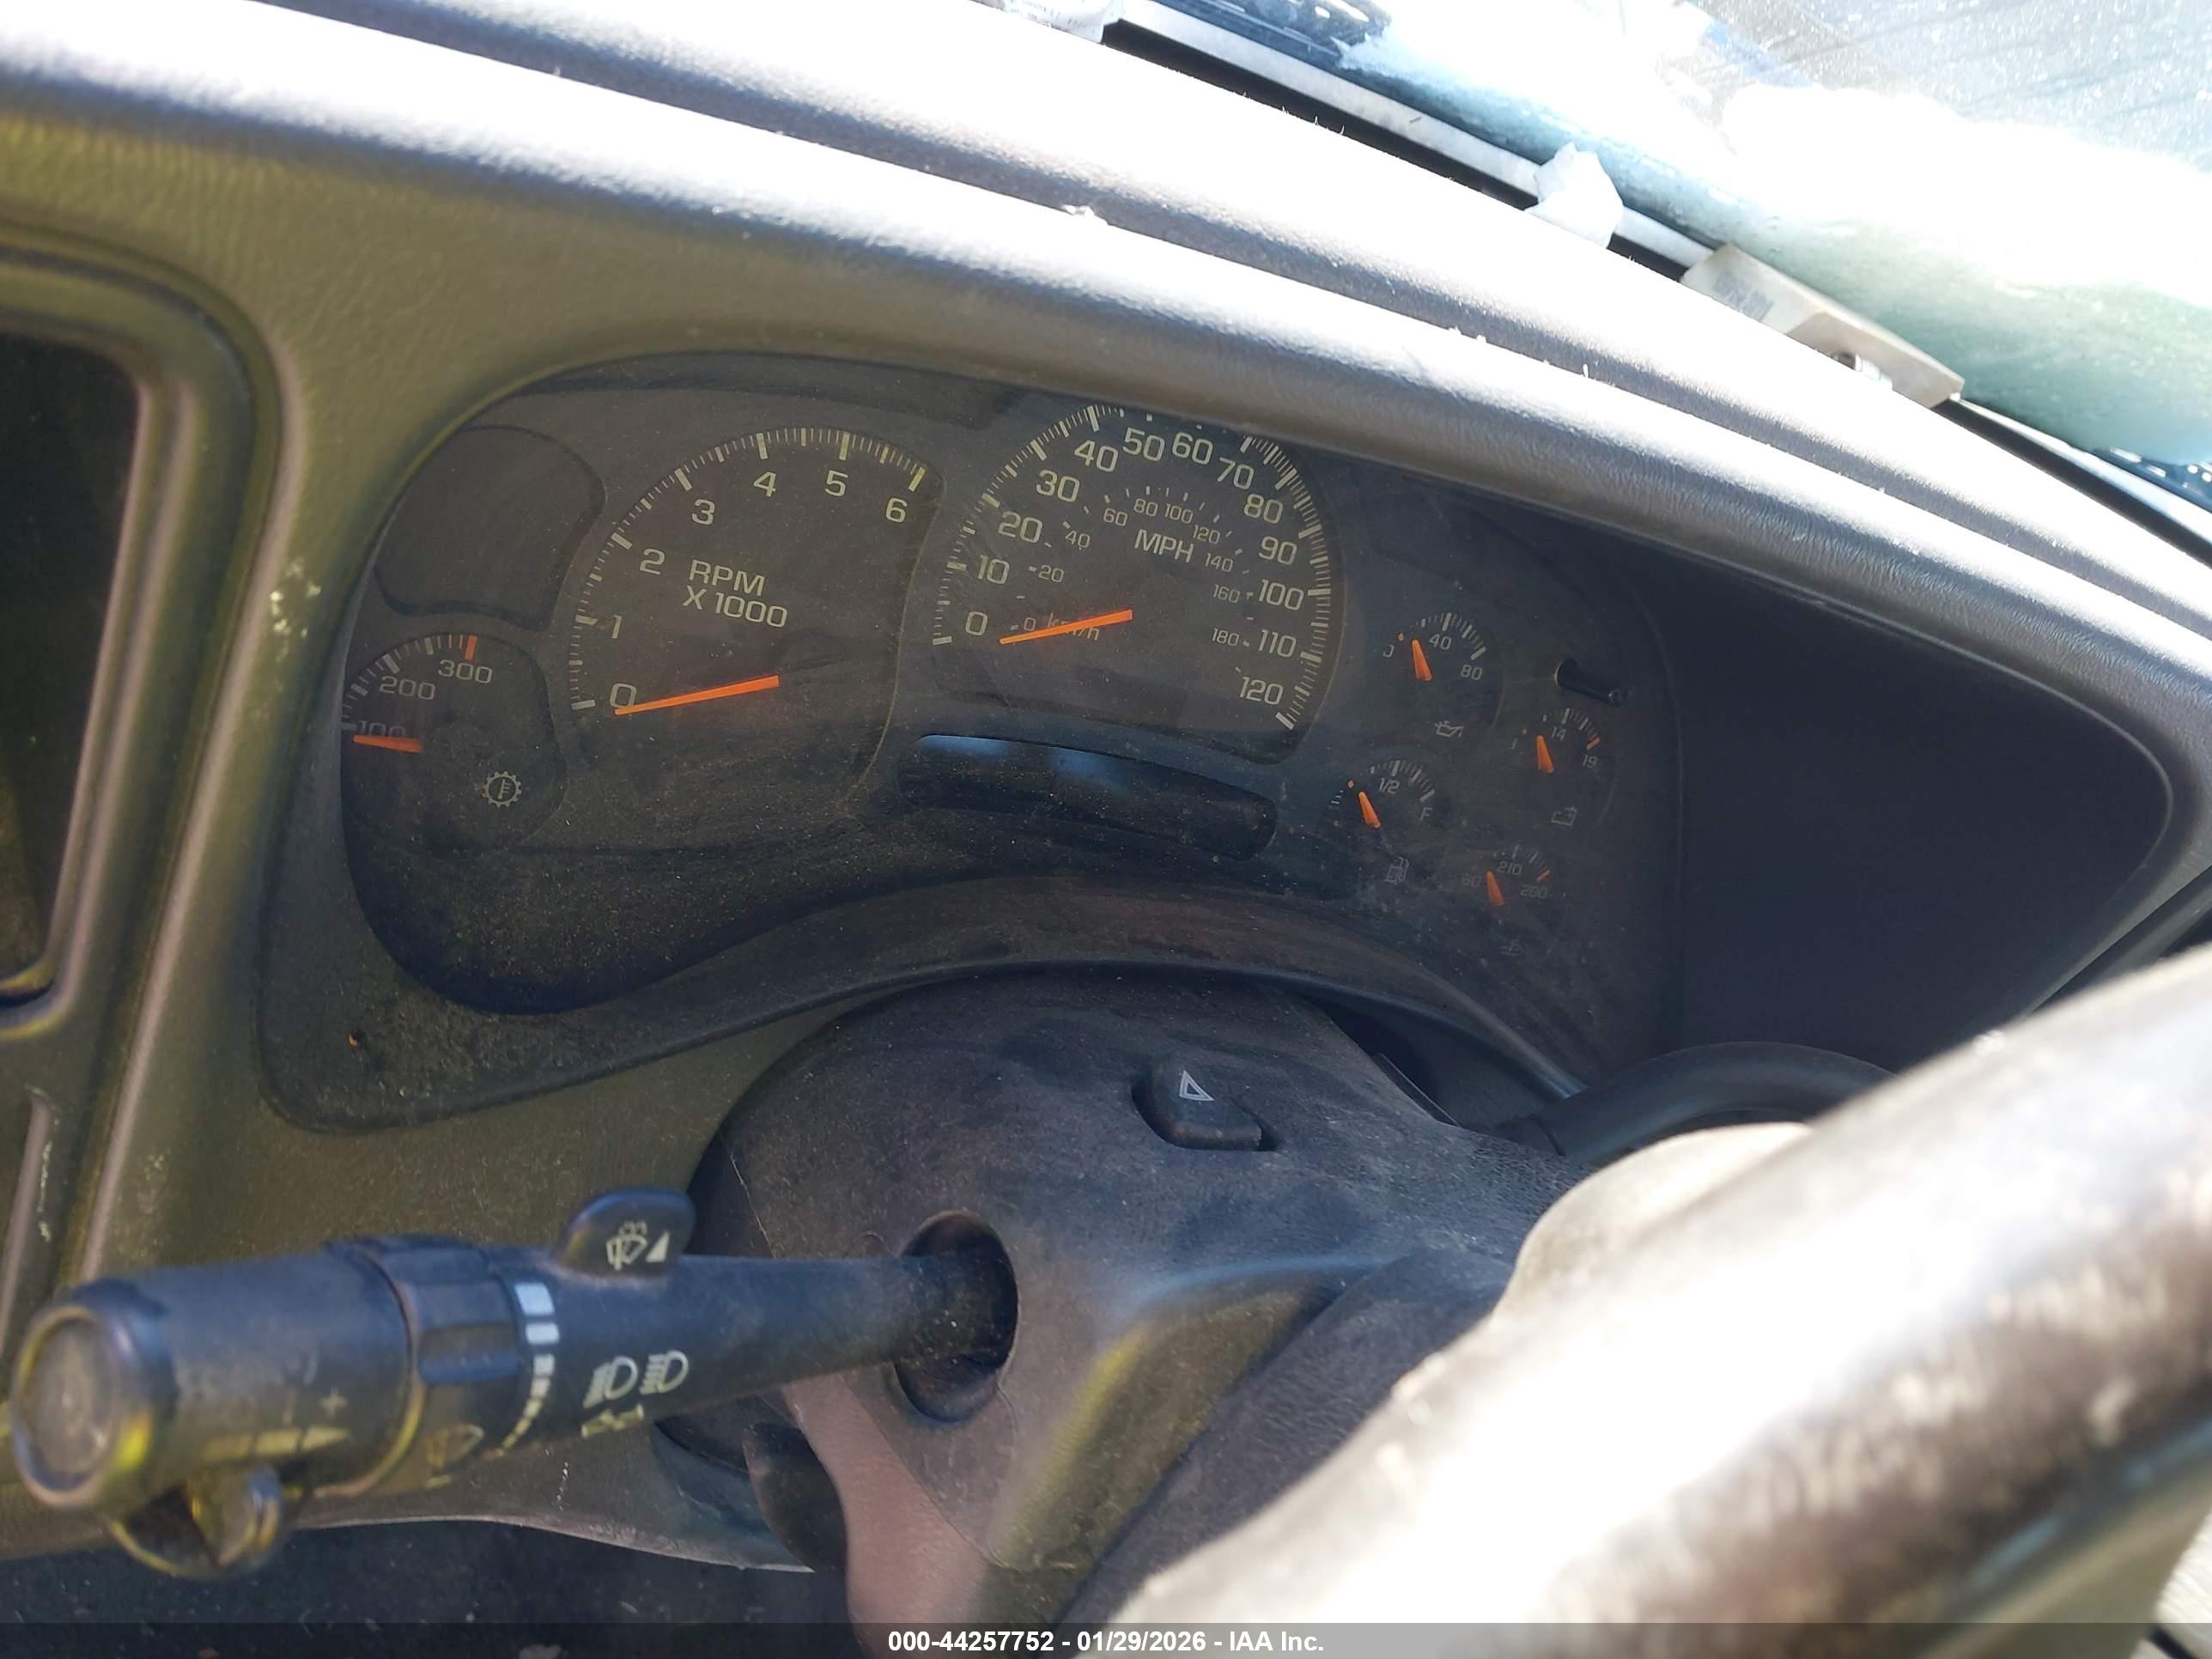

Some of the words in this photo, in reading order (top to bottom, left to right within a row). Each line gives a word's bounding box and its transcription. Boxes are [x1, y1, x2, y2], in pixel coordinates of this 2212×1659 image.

[1074, 440, 1118, 472] 40
[1122, 428, 1165, 461] 50
[1171, 432, 1213, 465] 60
[754, 471, 776, 496] 4
[824, 470, 848, 496] 5
[1036, 469, 1080, 502] 30
[1217, 457, 1255, 490] 70
[691, 499, 715, 525] 3
[885, 498, 908, 523] 6
[1103, 508, 1128, 526] 60
[1133, 499, 1158, 517] 80
[1164, 503, 1194, 525] 100
[1244, 494, 1283, 524] 80
[998, 511, 1042, 544] 20
[1065, 530, 1091, 549] 40
[1193, 525, 1220, 544] 120
[1134, 529, 1194, 562] MPH
[1259, 536, 1297, 565] 90
[639, 548, 665, 574] 2
[978, 555, 1010, 584] 10
[1206, 553, 1233, 572] 140
[689, 559, 765, 596] RPM
[1038, 565, 1064, 583] 20
[1213, 584, 1240, 603] 160
[1259, 580, 1304, 611] 100
[683, 585, 707, 611] X
[714, 592, 788, 629] 1000
[611, 615, 623, 639] 1
[965, 611, 988, 635] 0
[1212, 628, 1239, 646] 180
[1258, 629, 1297, 659] 110
[1429, 634, 1452, 651] 40
[438, 659, 493, 684] 300
[1461, 665, 1483, 681] 80
[379, 676, 436, 700] 200
[610, 683, 636, 709] 0
[1240, 677, 1283, 706] 120
[1551, 726, 1566, 742] 14
[1379, 778, 1401, 794] 1/2
[1419, 807, 1433, 822] F
[1497, 860, 1522, 876] 210
